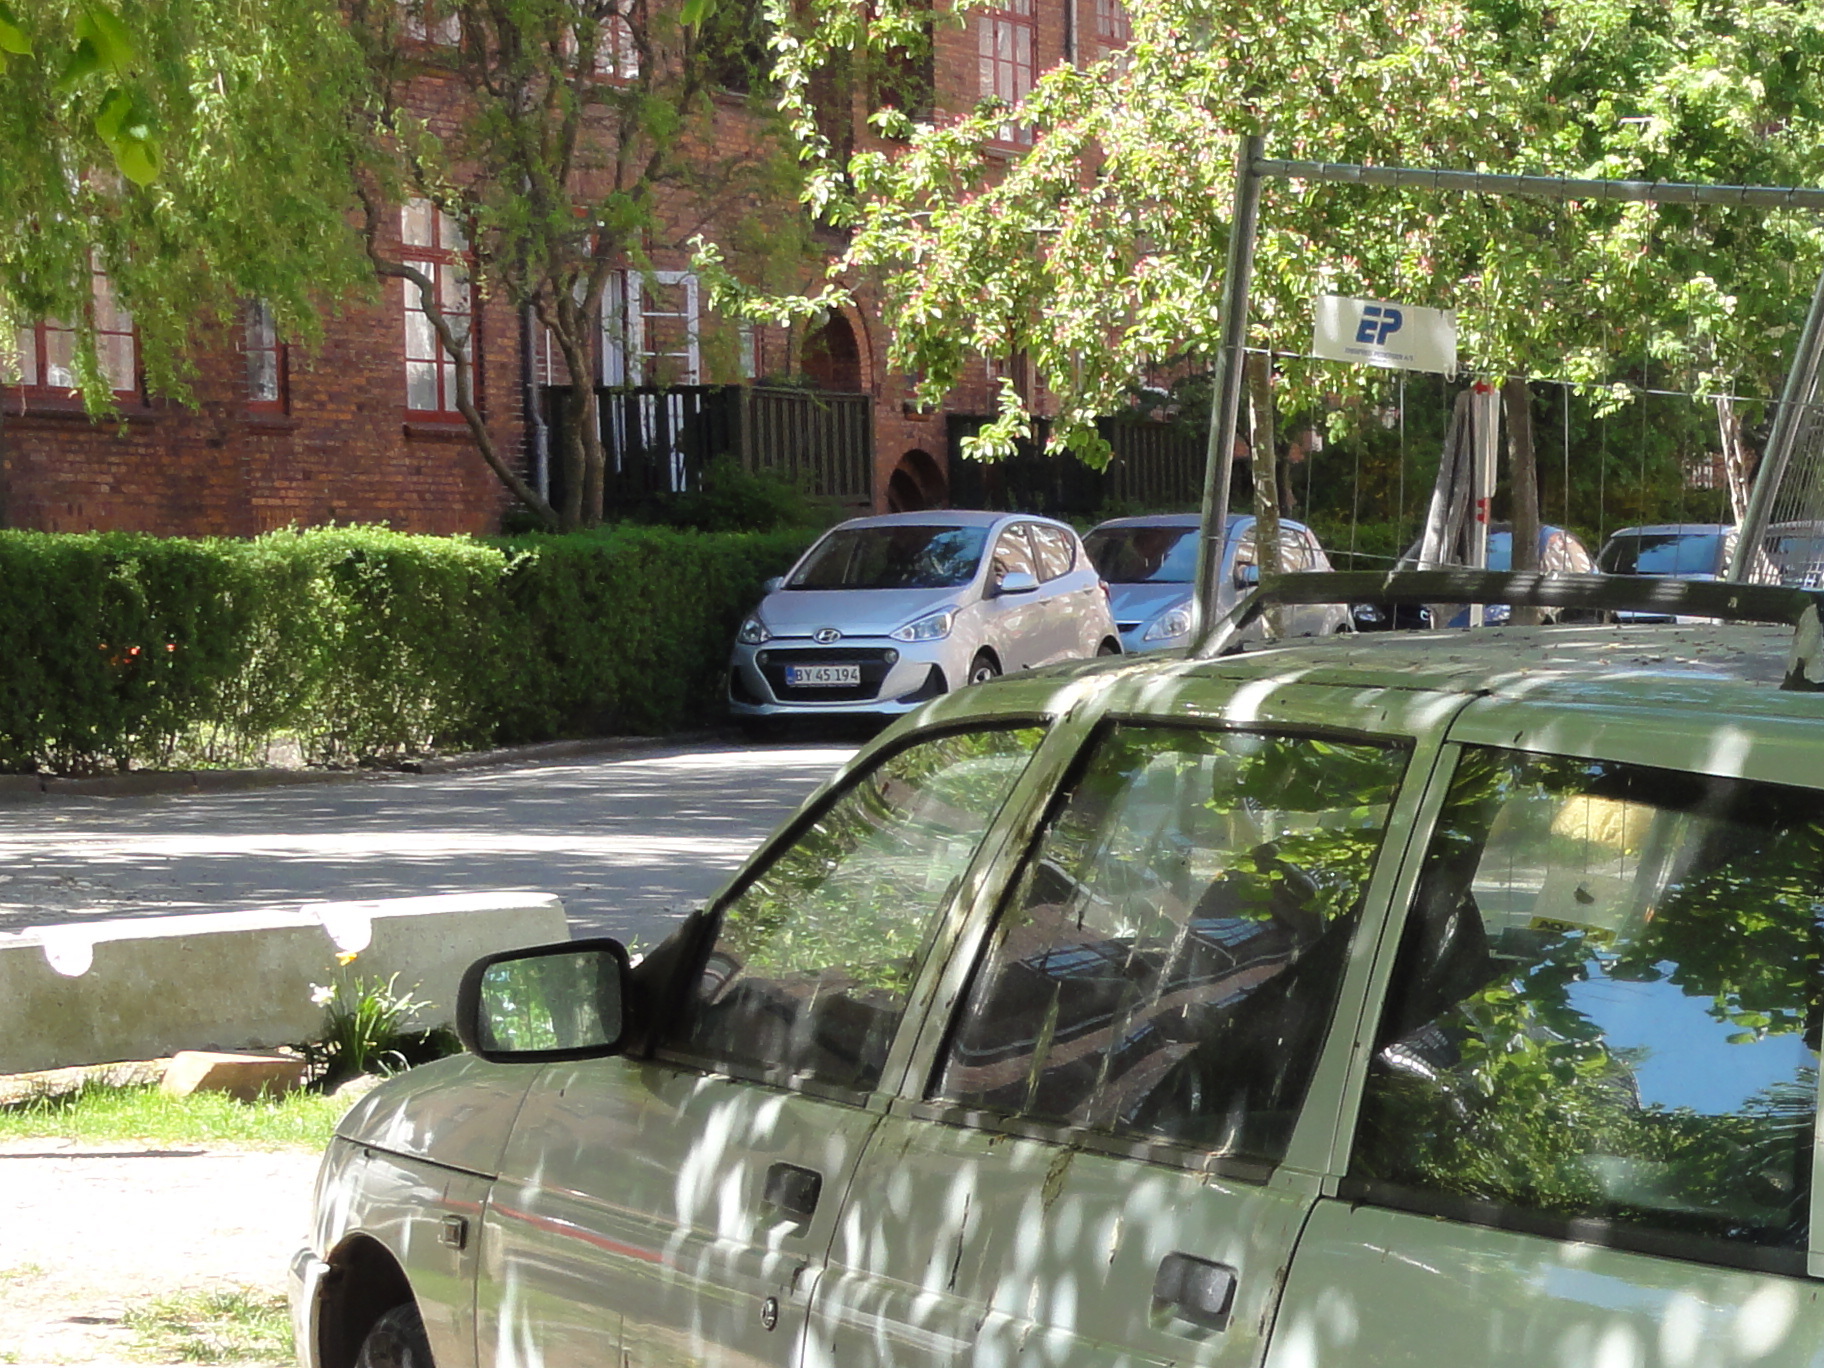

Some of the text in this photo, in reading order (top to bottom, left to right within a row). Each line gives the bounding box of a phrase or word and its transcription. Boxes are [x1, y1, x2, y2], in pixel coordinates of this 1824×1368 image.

[1356, 305, 1403, 346] EP
[795, 668, 858, 681] BY 45 194
